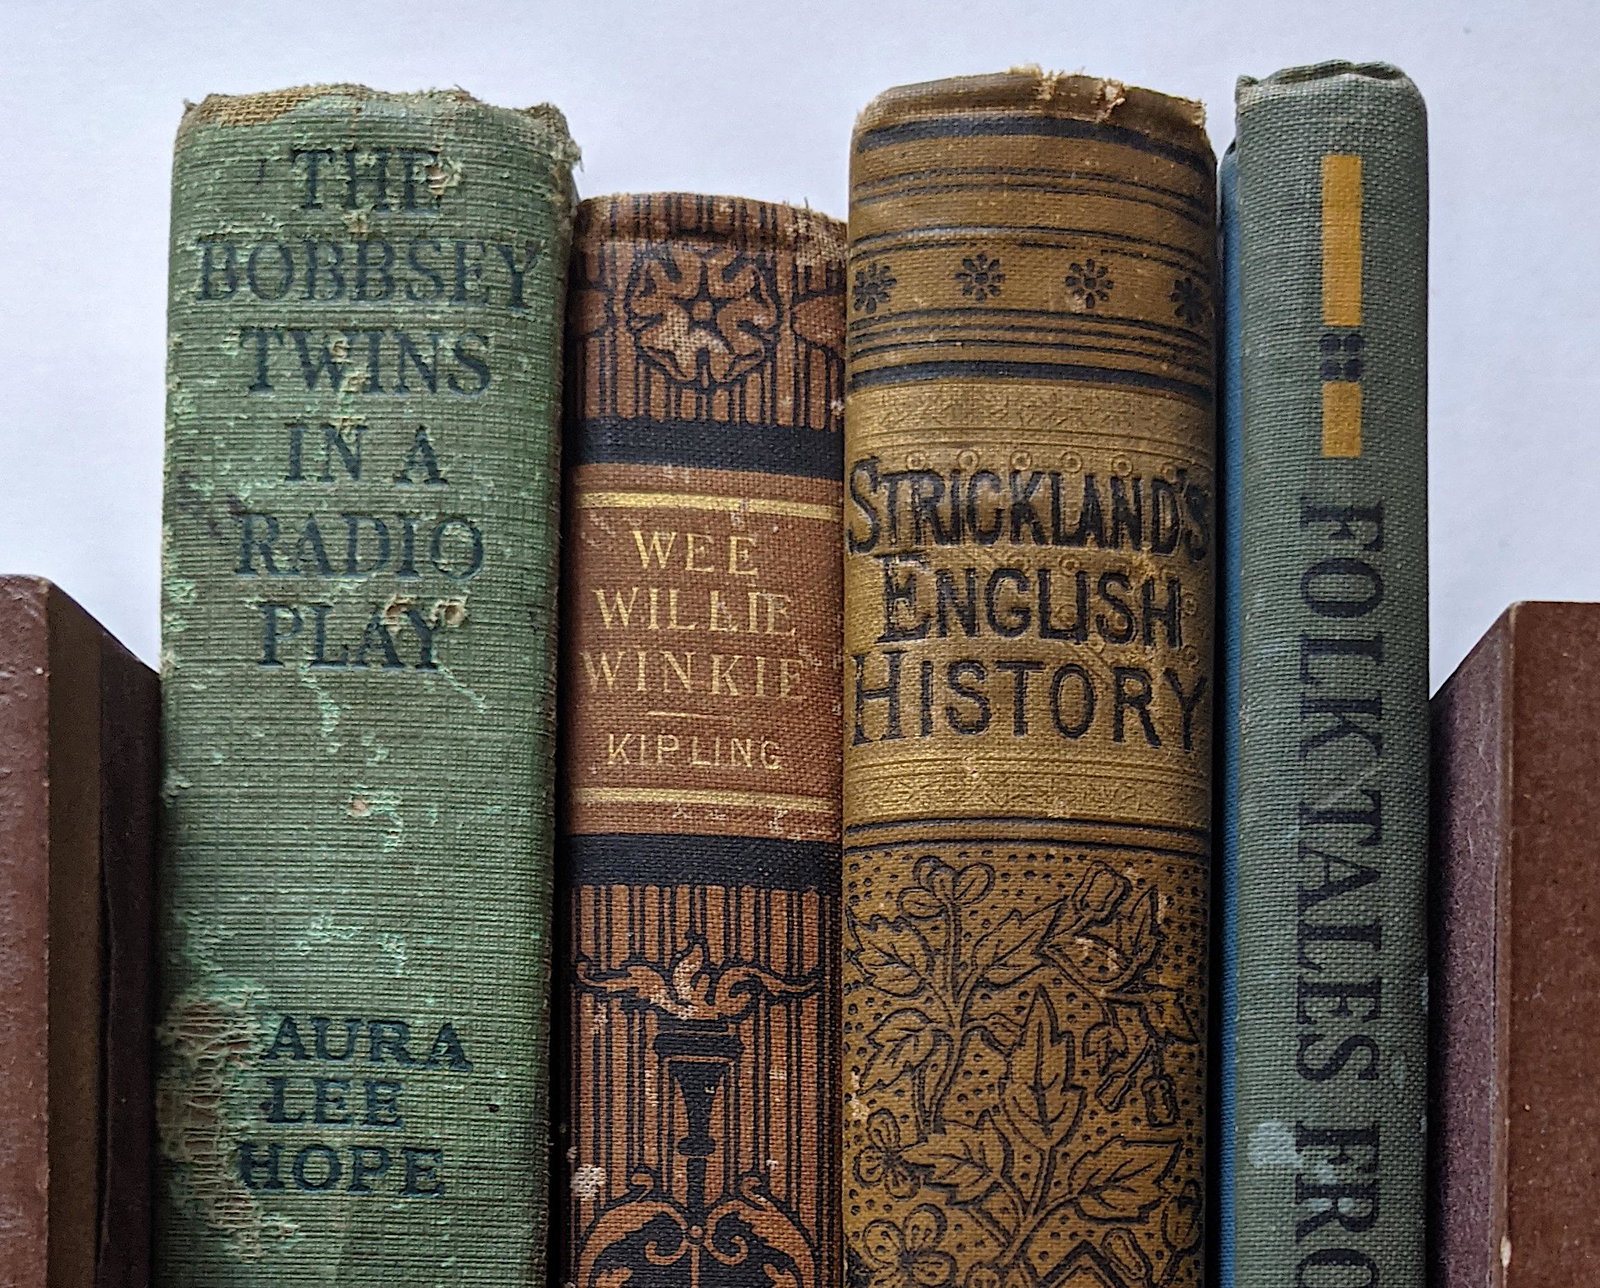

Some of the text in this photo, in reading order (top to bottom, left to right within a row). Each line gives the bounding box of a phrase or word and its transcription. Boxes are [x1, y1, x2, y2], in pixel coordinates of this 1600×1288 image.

[291, 147, 442, 215] THE
[198, 238, 543, 310] BOBBSEY
[238, 328, 492, 397] TWINS
[282, 422, 447, 485] IN A
[848, 455, 1209, 562] STRICKLAND'S
[235, 512, 485, 580] RADIO
[632, 530, 759, 576] WEE
[593, 586, 797, 637] WILLIE
[873, 550, 1184, 649] ENGLISH
[258, 601, 440, 670] PLAY
[578, 650, 805, 700] WINKIE
[849, 650, 1208, 754] HISTORY
[606, 732, 783, 770] KIPLING
[1297, 789, 1384, 1084] TALES
[259, 1014, 475, 1073] AURA
[265, 1076, 404, 1127] LEE
[235, 1141, 447, 1199] HOPE
